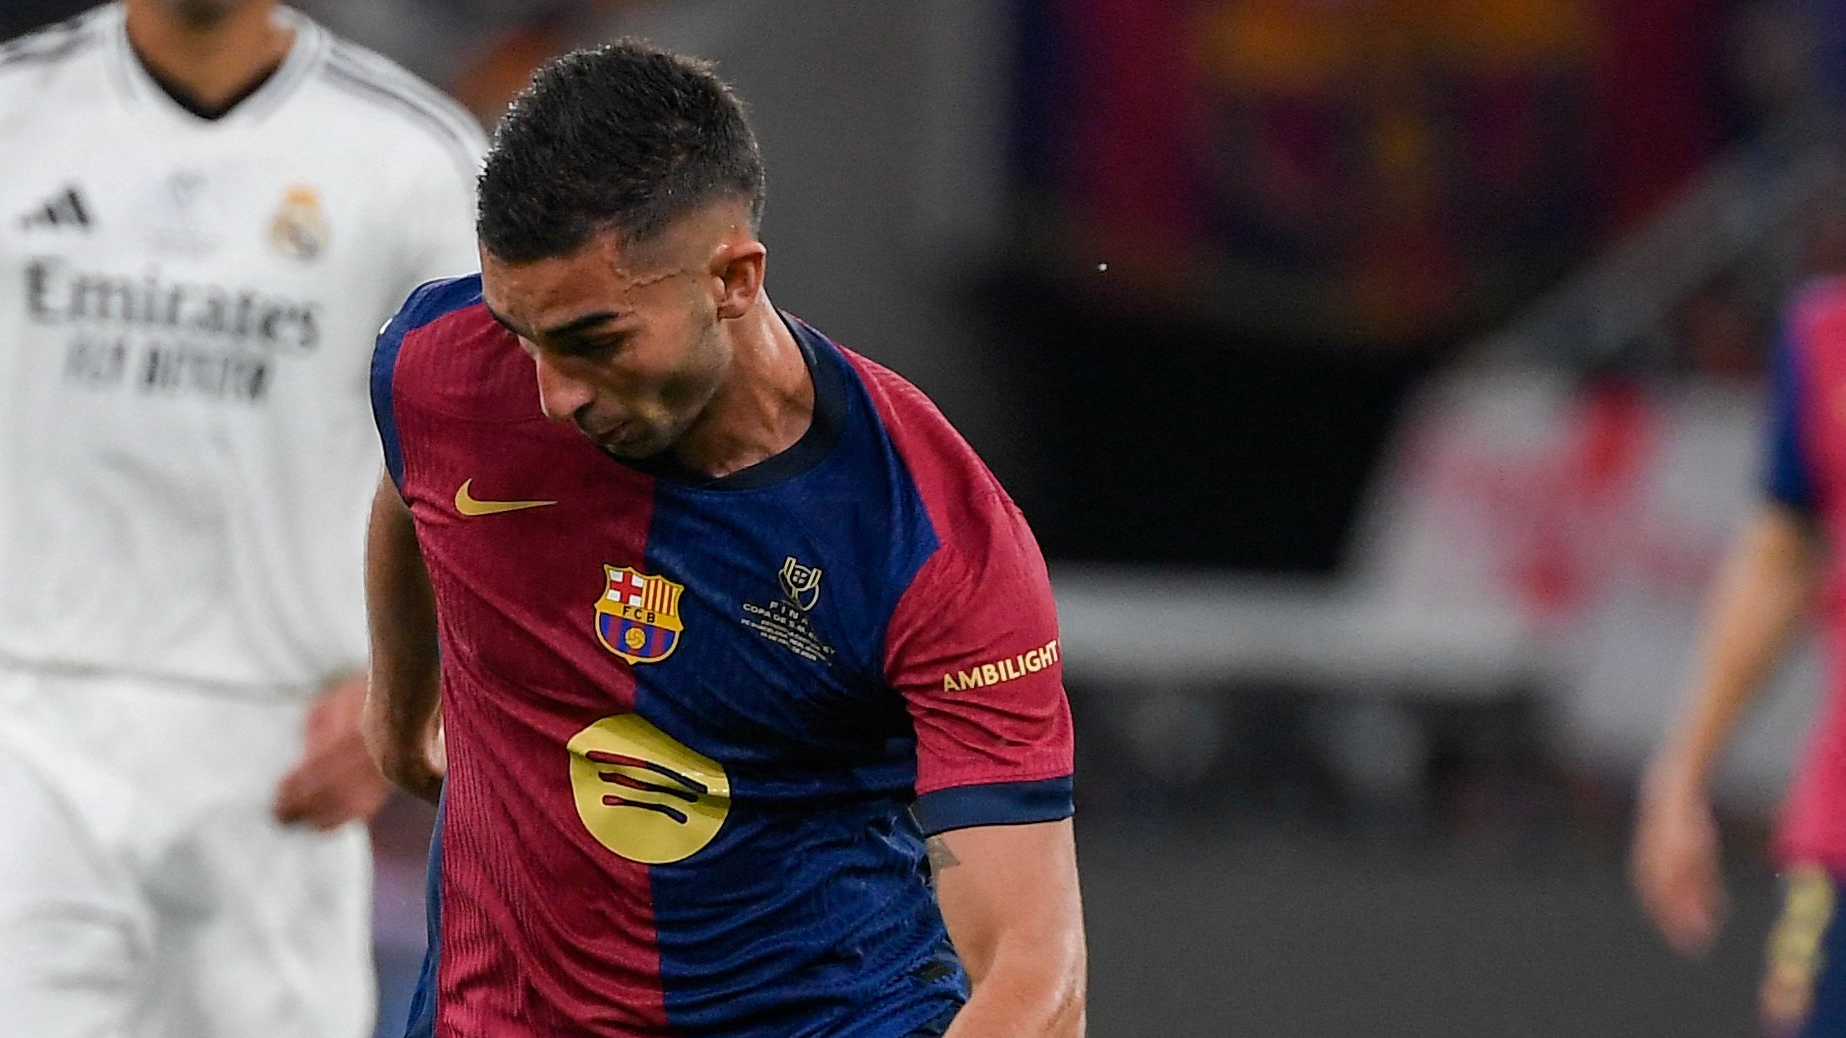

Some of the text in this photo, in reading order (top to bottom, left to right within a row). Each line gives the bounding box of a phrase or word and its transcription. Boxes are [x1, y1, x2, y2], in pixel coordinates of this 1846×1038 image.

[623, 605, 656, 624] FCB
[742, 603, 771, 618] COPA
[943, 640, 1059, 692] AMBILIGHT
